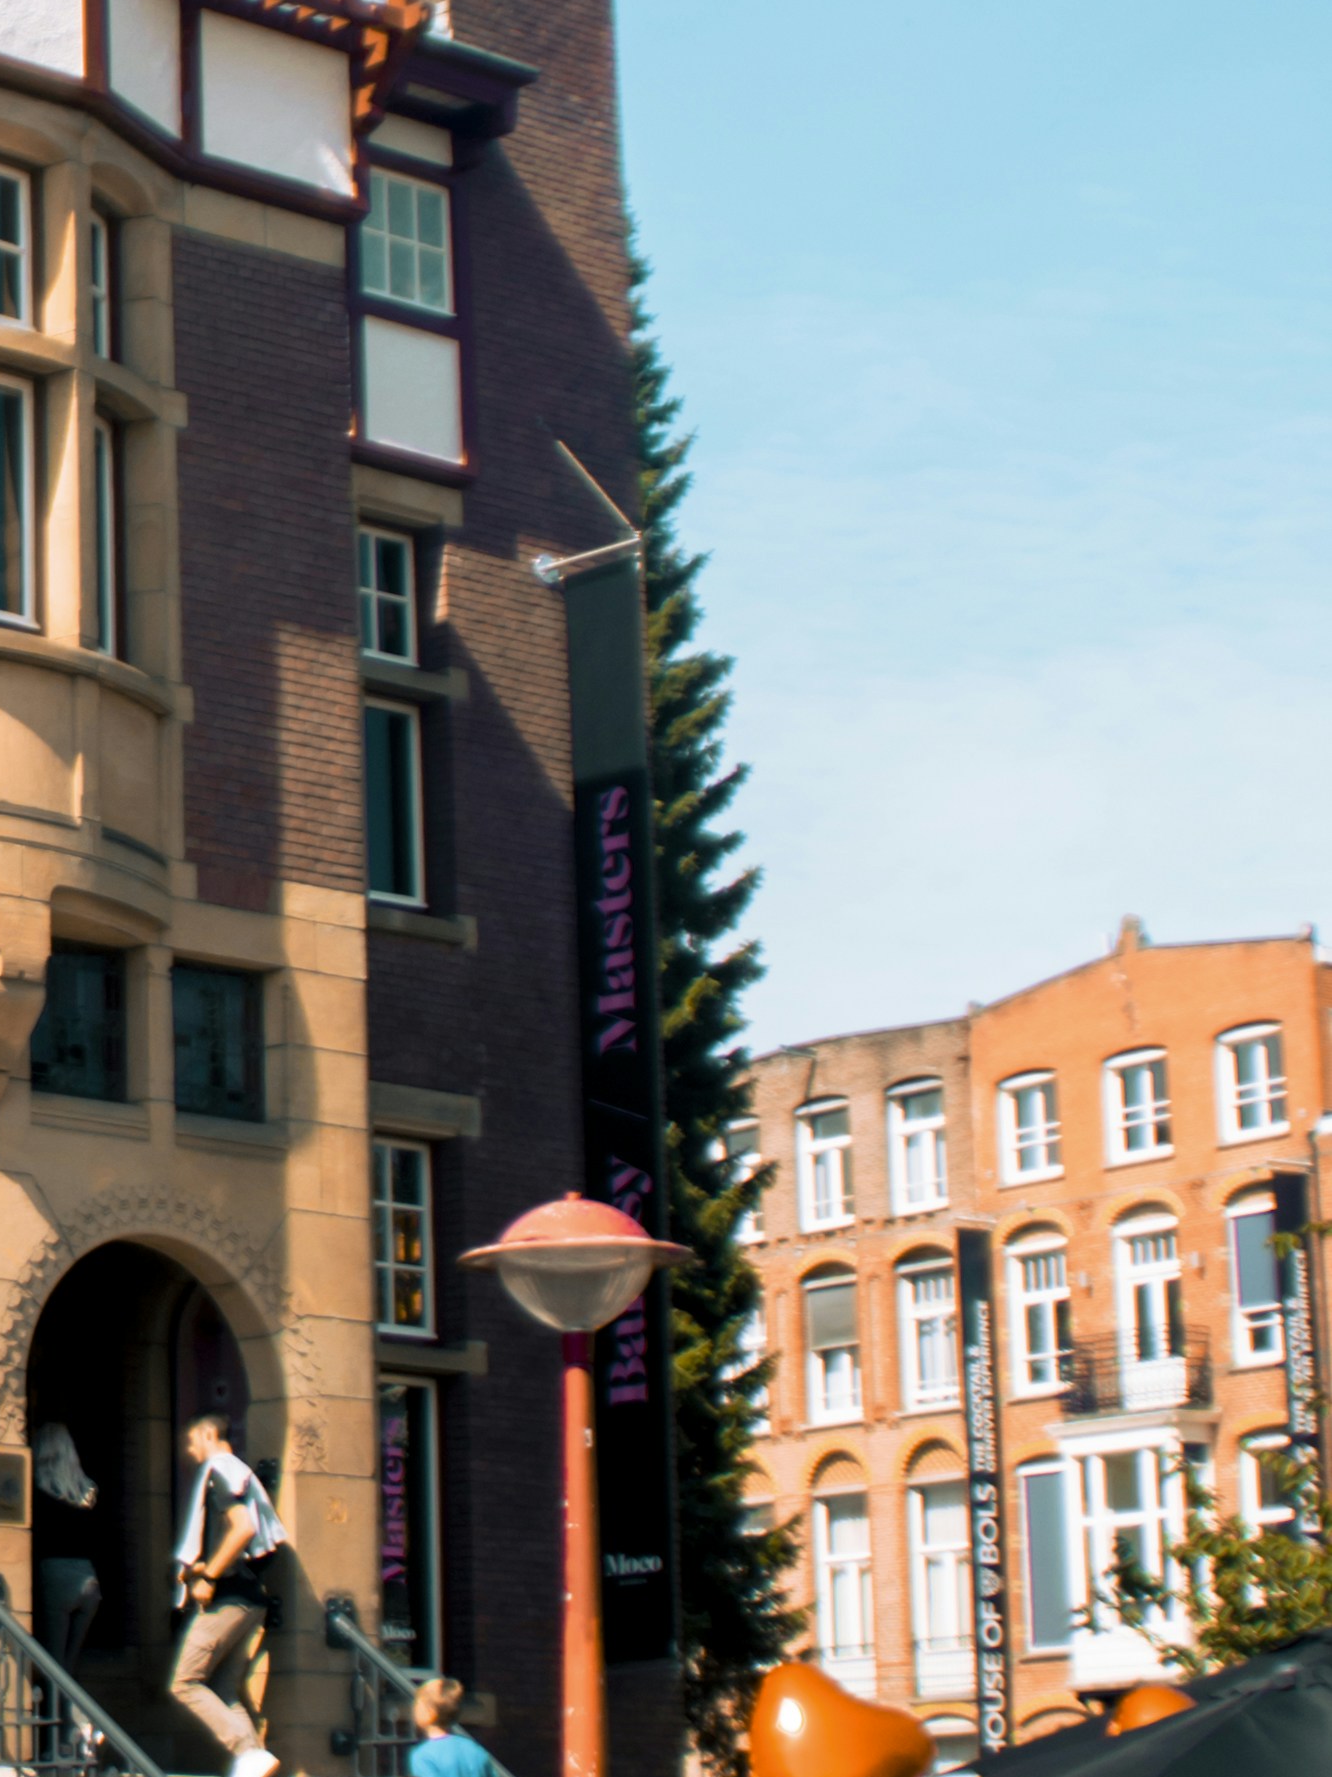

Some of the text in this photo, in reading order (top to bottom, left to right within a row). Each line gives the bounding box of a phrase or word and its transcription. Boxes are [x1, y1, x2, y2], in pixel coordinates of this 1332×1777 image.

[595, 785, 653, 1406] Basy Masters
[977, 1300, 994, 1396] EXPERIENCE
[970, 1362, 984, 1439] COCKTAIL
[978, 1484, 1000, 1565] BOLS
[603, 1553, 663, 1576] Moco
[982, 1599, 1003, 1649] OF
